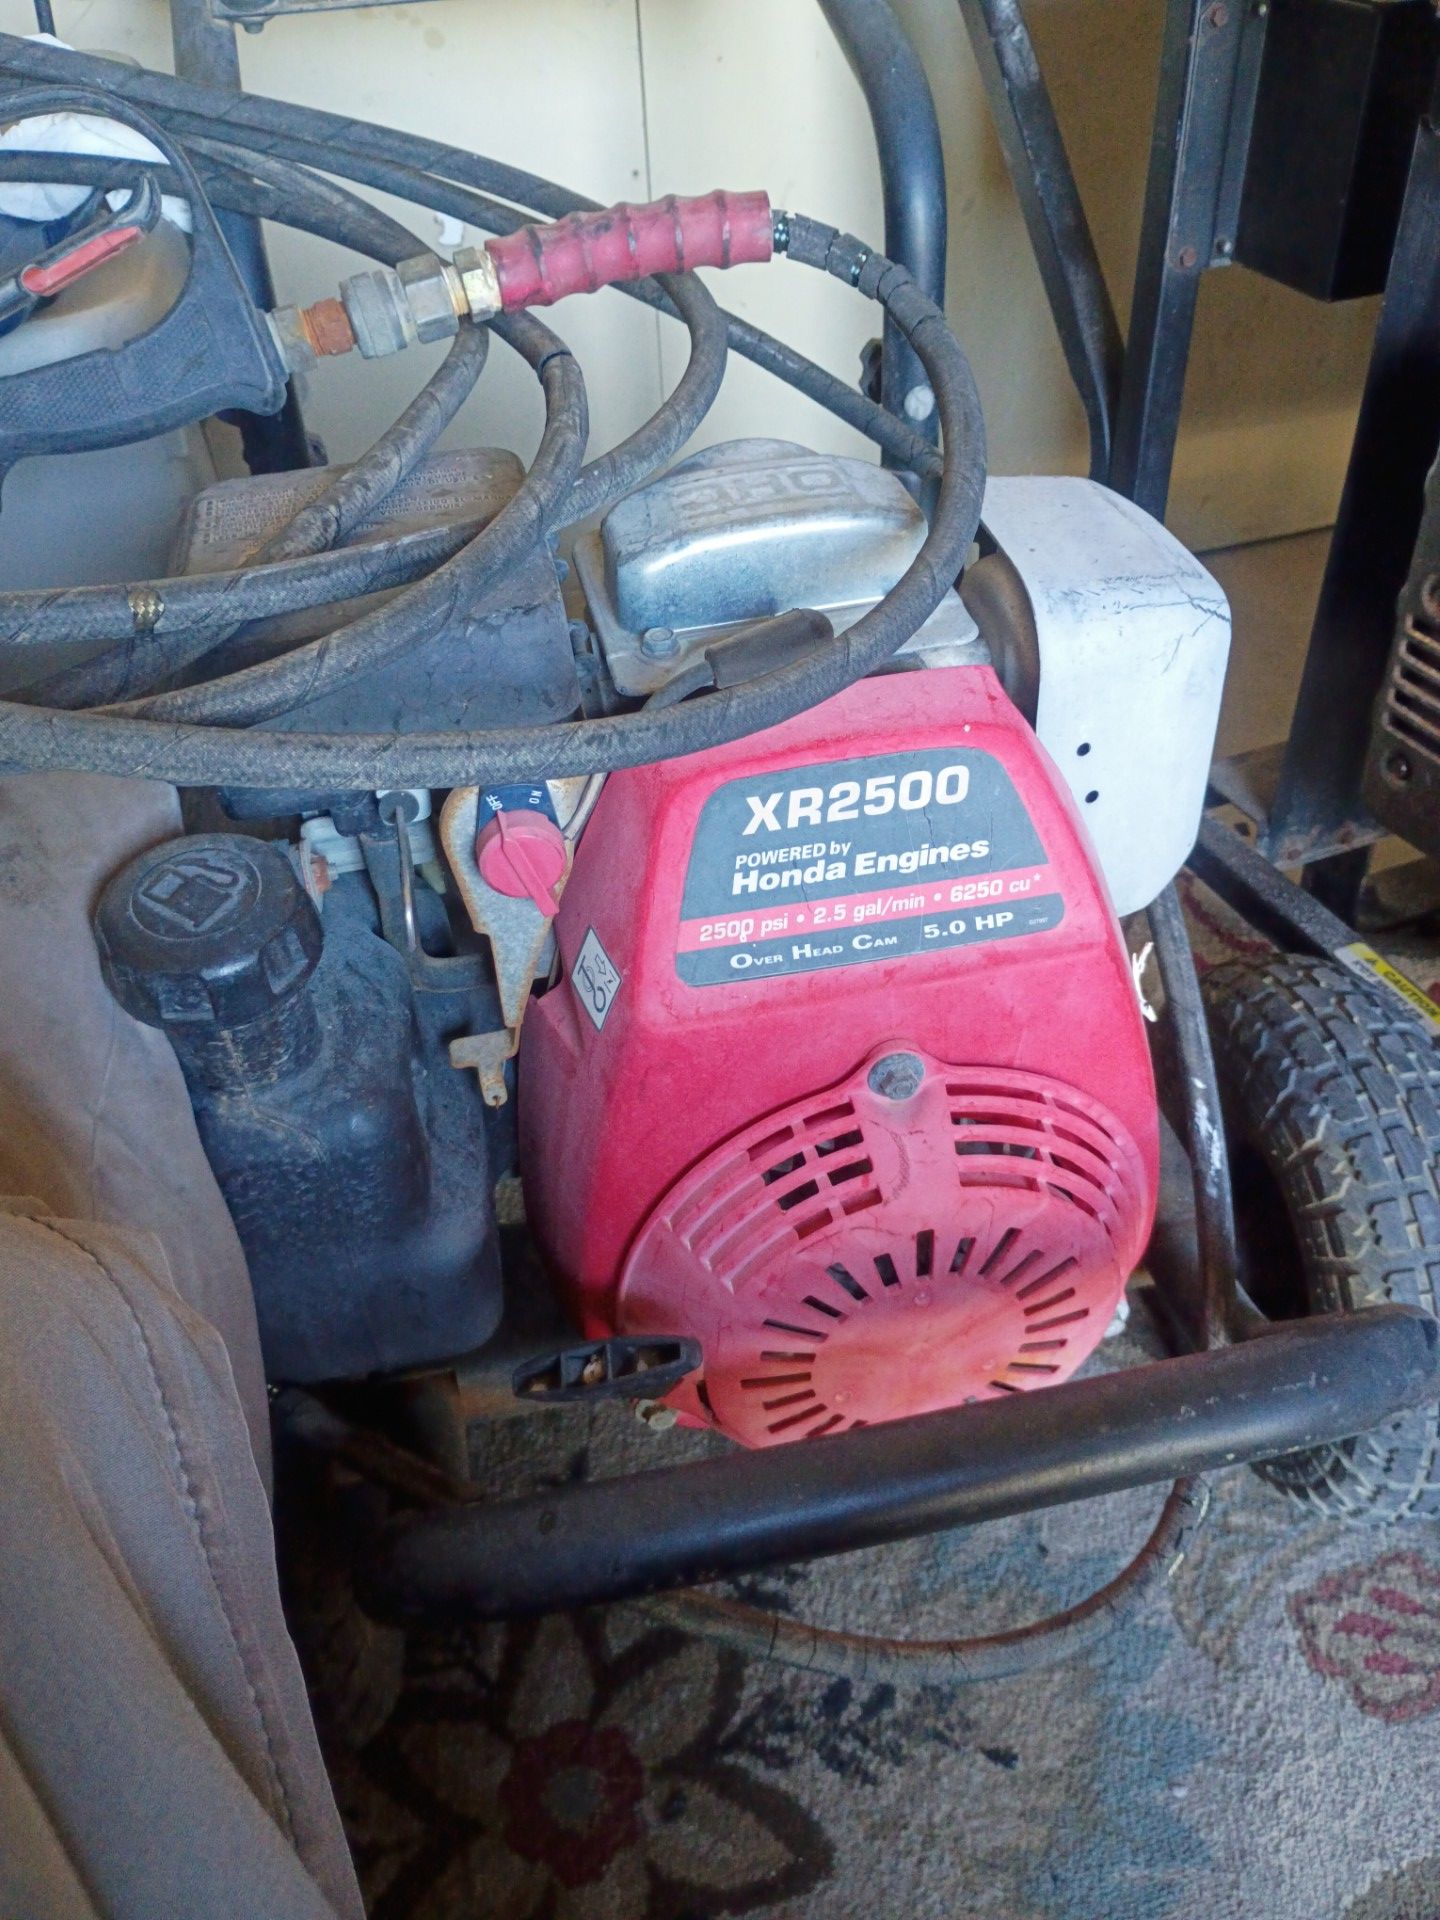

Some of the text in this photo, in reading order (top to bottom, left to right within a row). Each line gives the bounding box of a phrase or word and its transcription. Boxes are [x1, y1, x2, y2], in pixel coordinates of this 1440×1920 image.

[486, 794, 503, 811] OFF
[528, 790, 543, 804] ON
[742, 765, 969, 836] XR2500
[732, 839, 990, 895] Honda Engines
[735, 841, 851, 869] POWERED by
[700, 918, 754, 942] 2500
[760, 913, 788, 937] psi
[813, 904, 847, 924] 2.5
[853, 893, 925, 922] gal/min
[950, 879, 1003, 903] 6250
[923, 920, 967, 939] 5.0
[975, 911, 1014, 931] HP
[1383, 971, 1438, 1016] CAUTION
